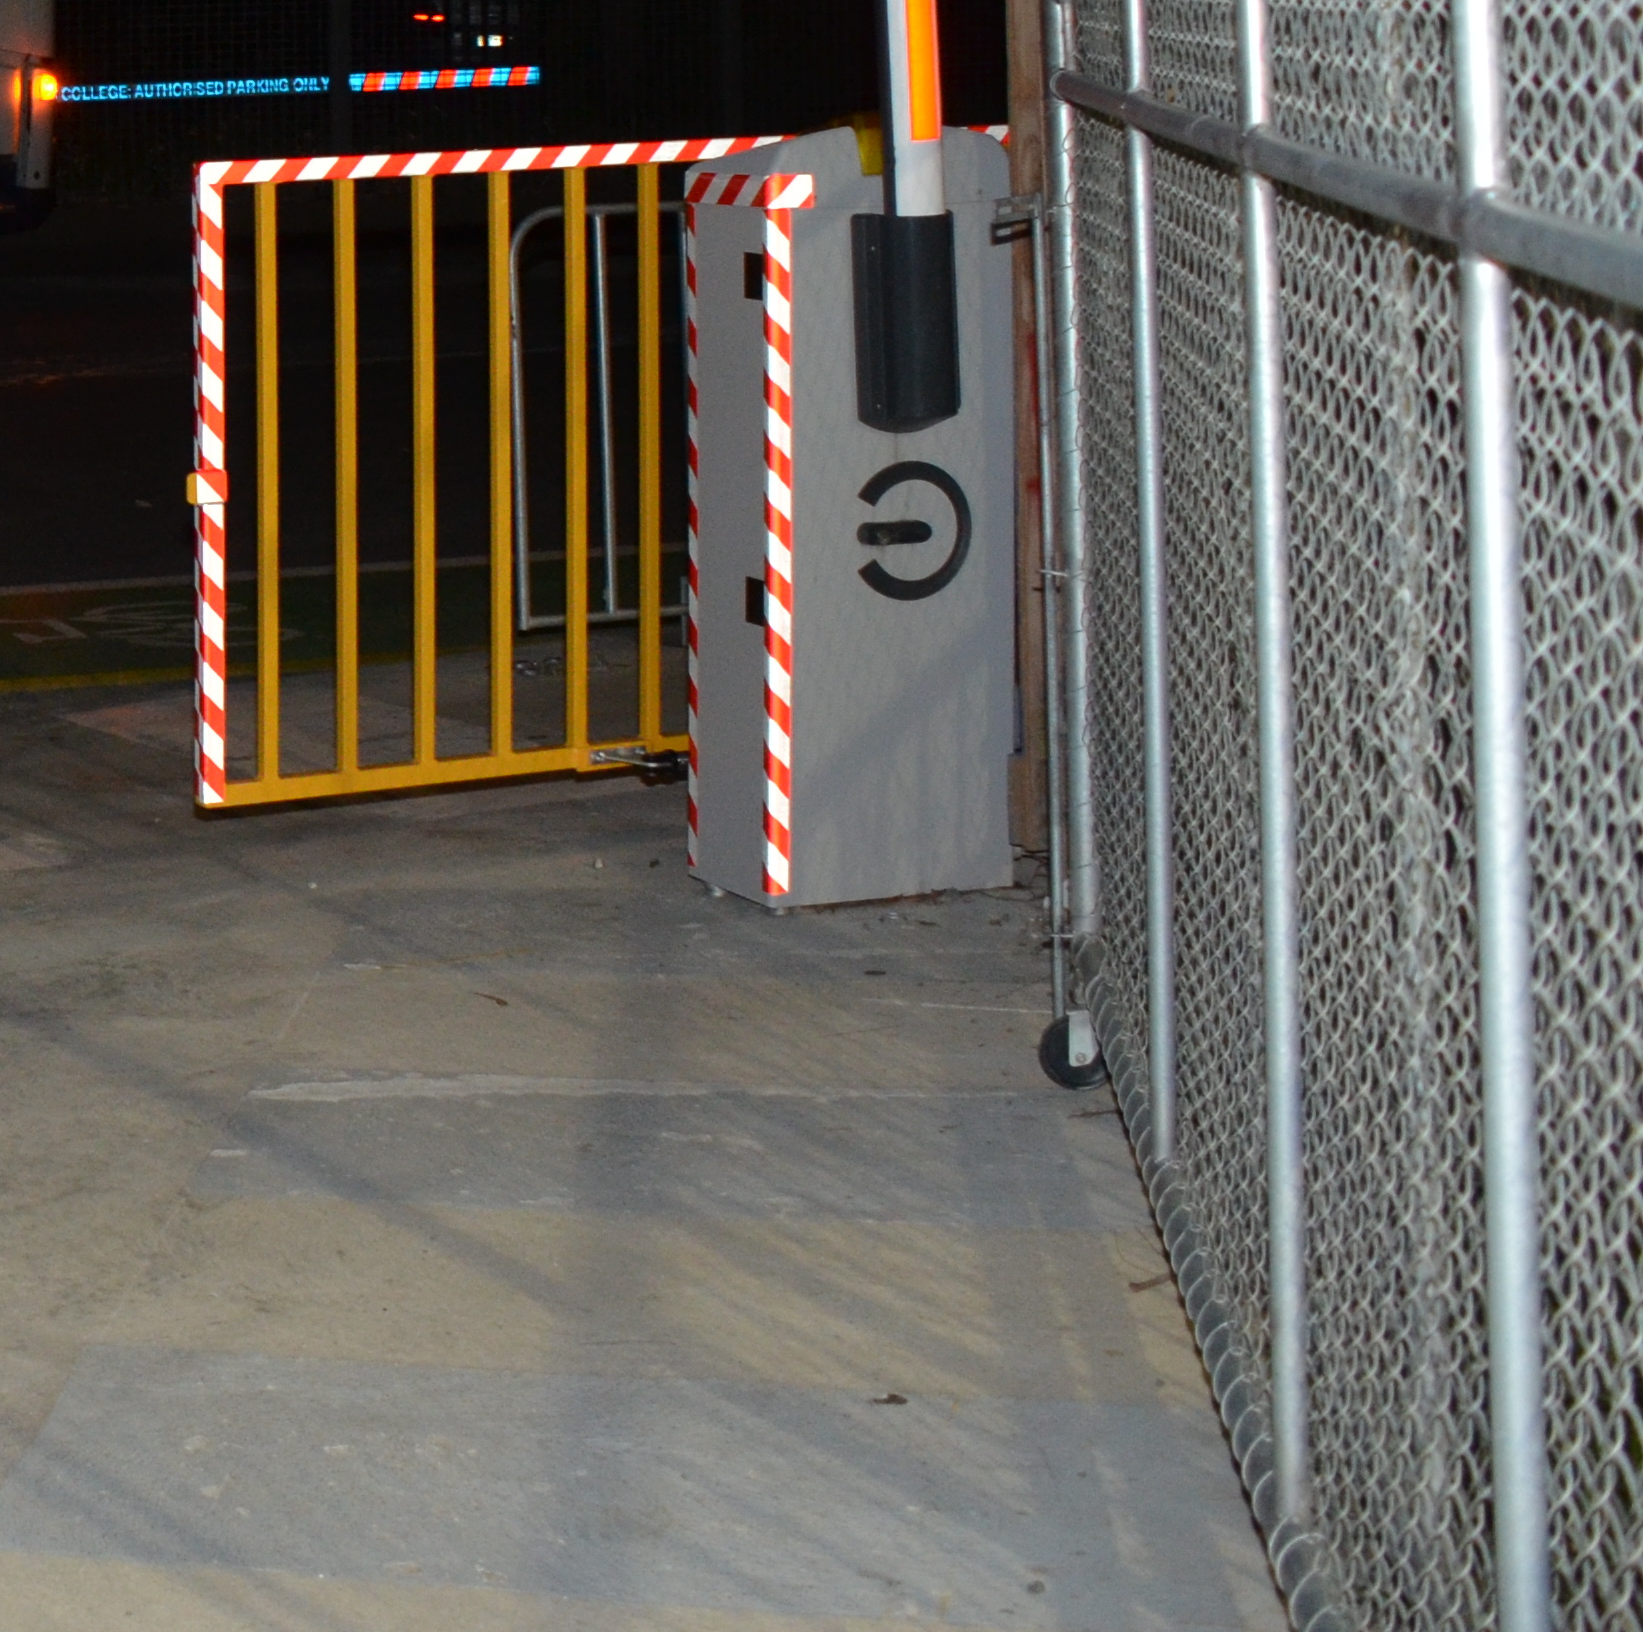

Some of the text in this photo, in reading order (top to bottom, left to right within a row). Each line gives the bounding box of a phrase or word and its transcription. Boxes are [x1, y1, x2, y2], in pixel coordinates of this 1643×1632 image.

[134, 81, 224, 99] AUTHORISED
[226, 78, 290, 95] PARKING
[293, 76, 330, 92] ONLY
